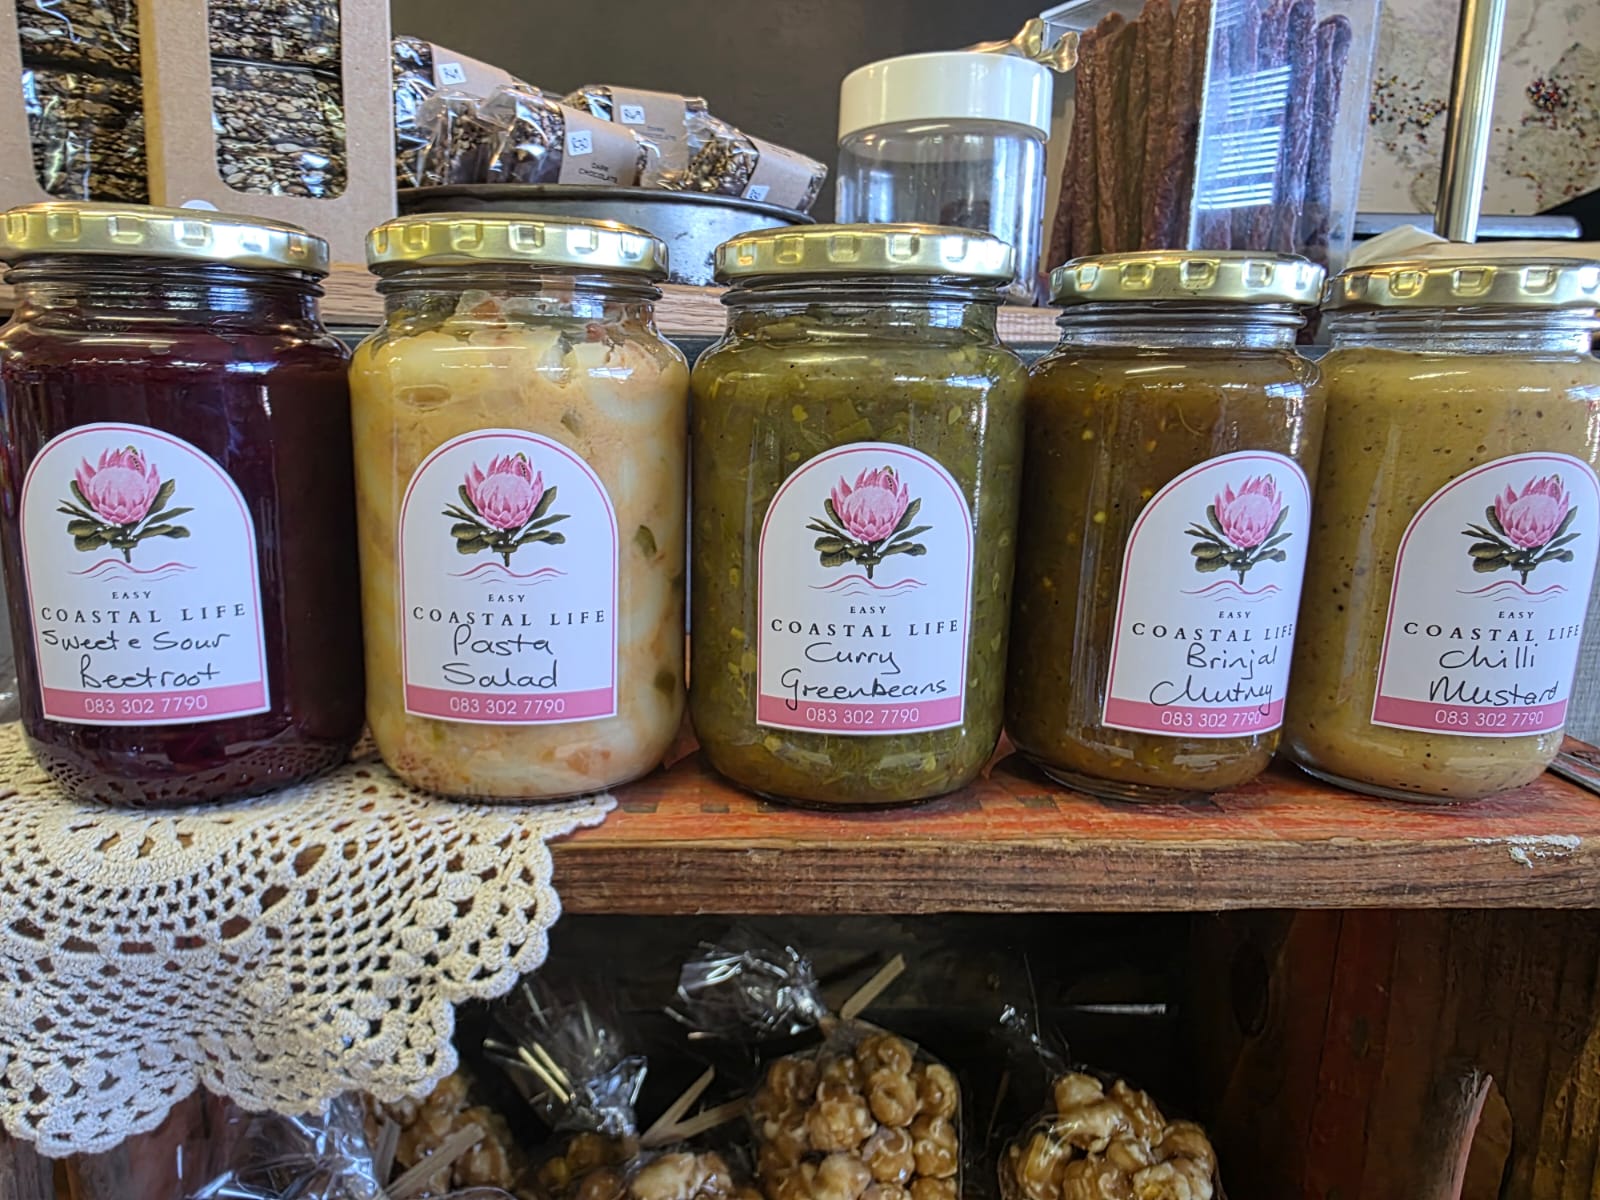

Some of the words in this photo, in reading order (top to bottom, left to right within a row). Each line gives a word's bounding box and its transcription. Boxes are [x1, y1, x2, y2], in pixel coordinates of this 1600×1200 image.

[112, 591, 153, 600] EASY
[487, 594, 526, 602] EASY
[41, 607, 162, 624] COASTAL
[181, 603, 246, 622] LIFE
[413, 606, 532, 627] COASTAL
[550, 610, 605, 626] LIFE
[850, 606, 888, 615] EASY
[1218, 610, 1252, 619] EASY
[1498, 611, 1535, 619] EASY
[771, 618, 892, 638] COASTAL
[909, 619, 959, 636] LIFE
[1132, 622, 1252, 642] COASTAL
[1404, 622, 1535, 642] COASTAL
[1547, 624, 1580, 641] LIFE
[42, 630, 120, 651] Sweet
[152, 631, 232, 651] Sour
[454, 623, 554, 656] Pasta
[804, 642, 901, 675] Curry
[1186, 642, 1278, 680] Brinjal
[79, 654, 221, 689] Beetroot
[442, 659, 558, 689] Salad
[781, 668, 948, 711] Greenbeans
[1429, 675, 1560, 706] Mustard
[84, 697, 116, 714] 083
[121, 698, 155, 715] 302
[161, 695, 209, 714] 7790
[450, 697, 480, 713] 083
[485, 699, 517, 715] 302
[523, 698, 565, 715] 7790
[806, 707, 837, 723] 083
[843, 709, 874, 725] 302
[881, 707, 920, 725] 7790
[1161, 711, 1193, 728] 083
[1198, 713, 1227, 728] 302
[1231, 711, 1262, 727] 7790
[1435, 709, 1469, 726] 083
[1475, 712, 1506, 728] 302
[1510, 710, 1544, 727] 7790
